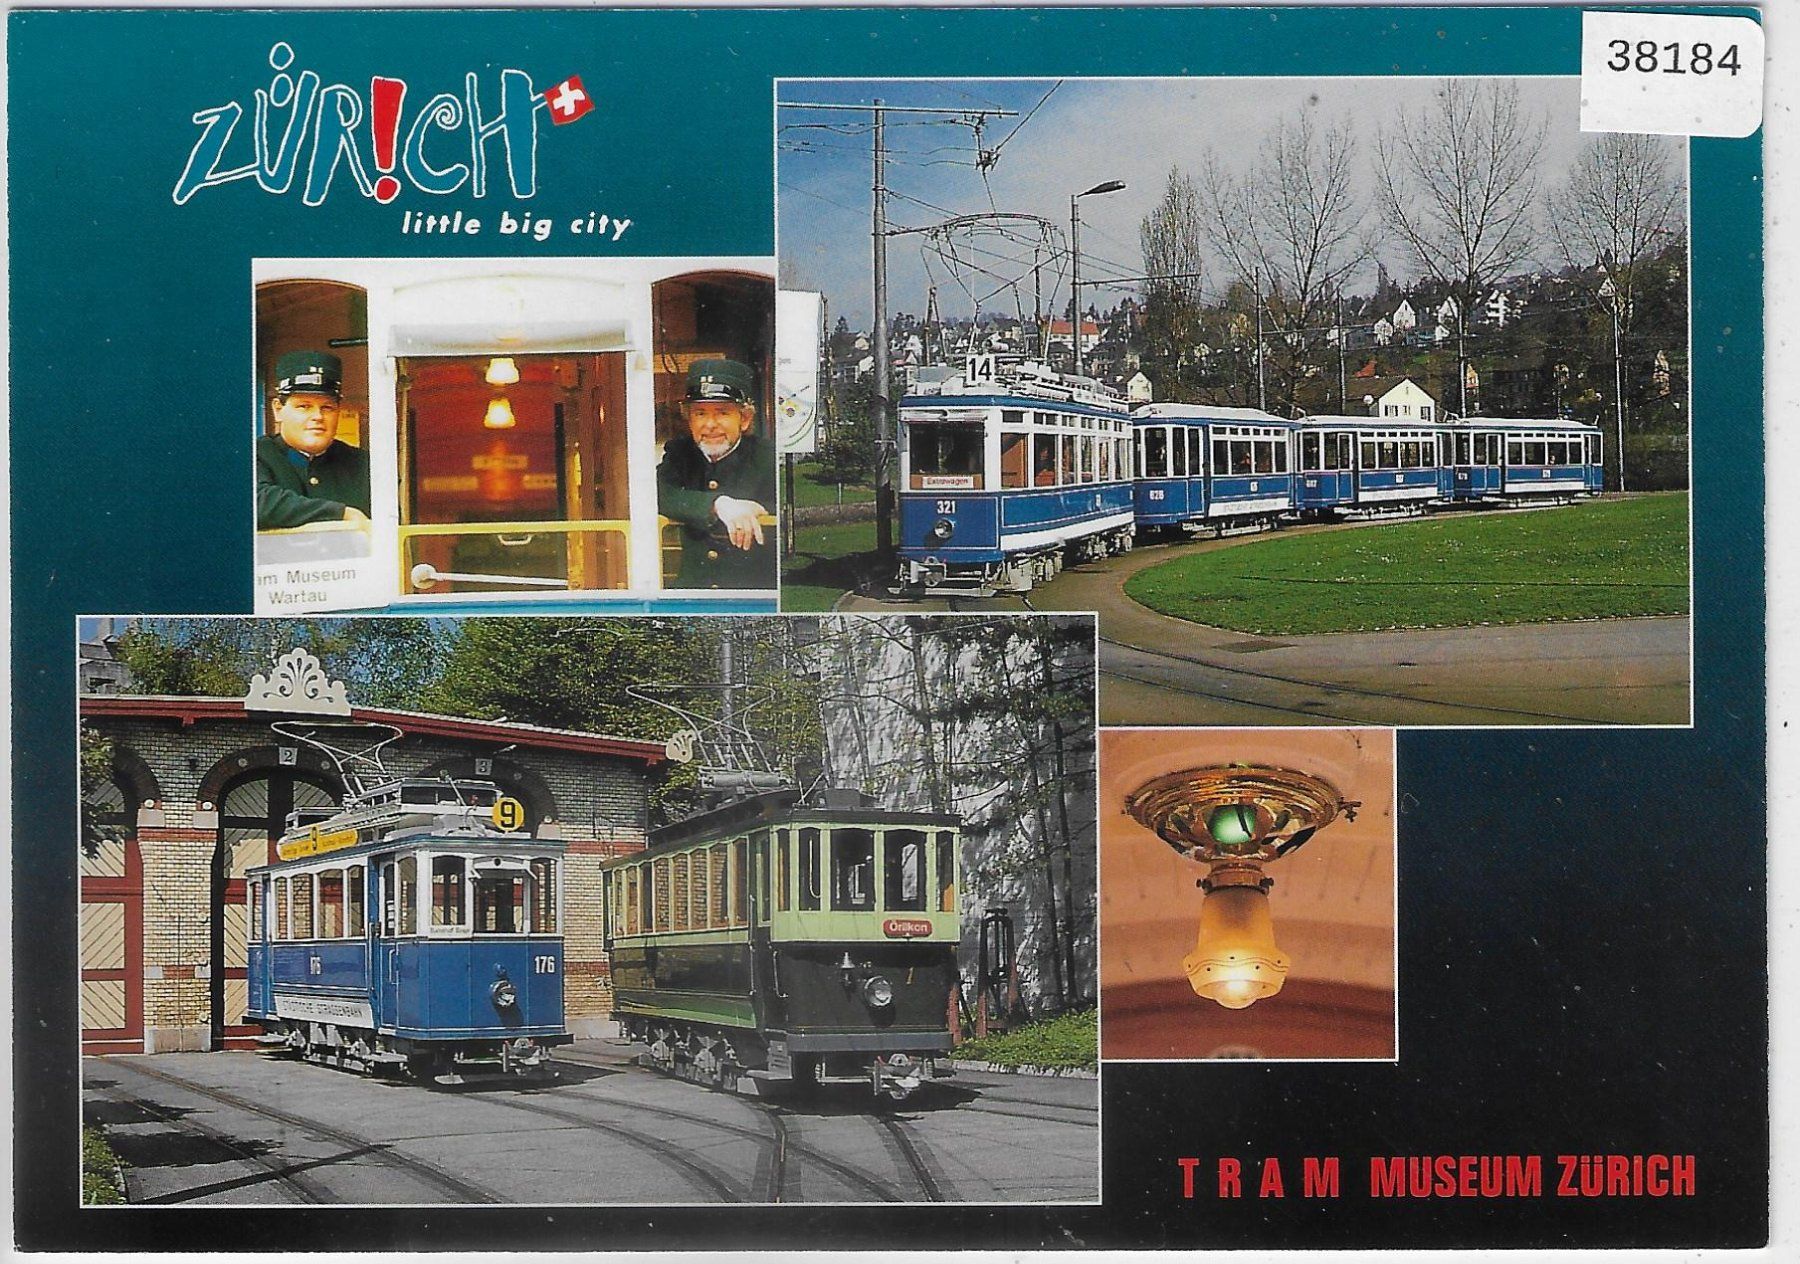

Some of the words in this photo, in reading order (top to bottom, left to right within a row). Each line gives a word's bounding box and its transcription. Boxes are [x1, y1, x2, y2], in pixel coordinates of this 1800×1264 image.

[1606, 39, 1741, 76] 38184
[402, 210, 481, 234] little
[499, 211, 553, 241] big
[570, 211, 632, 241] city
[968, 357, 992, 381] 14
[937, 500, 956, 514] 321
[286, 569, 356, 584] Museum
[269, 590, 328, 605] Wartau
[284, 751, 293, 763] 2
[500, 801, 516, 828] 9
[534, 955, 555, 974] 176
[1370, 1155, 1542, 1197] MUSEUM
[1556, 1154, 1696, 1197] ZÜRICH
